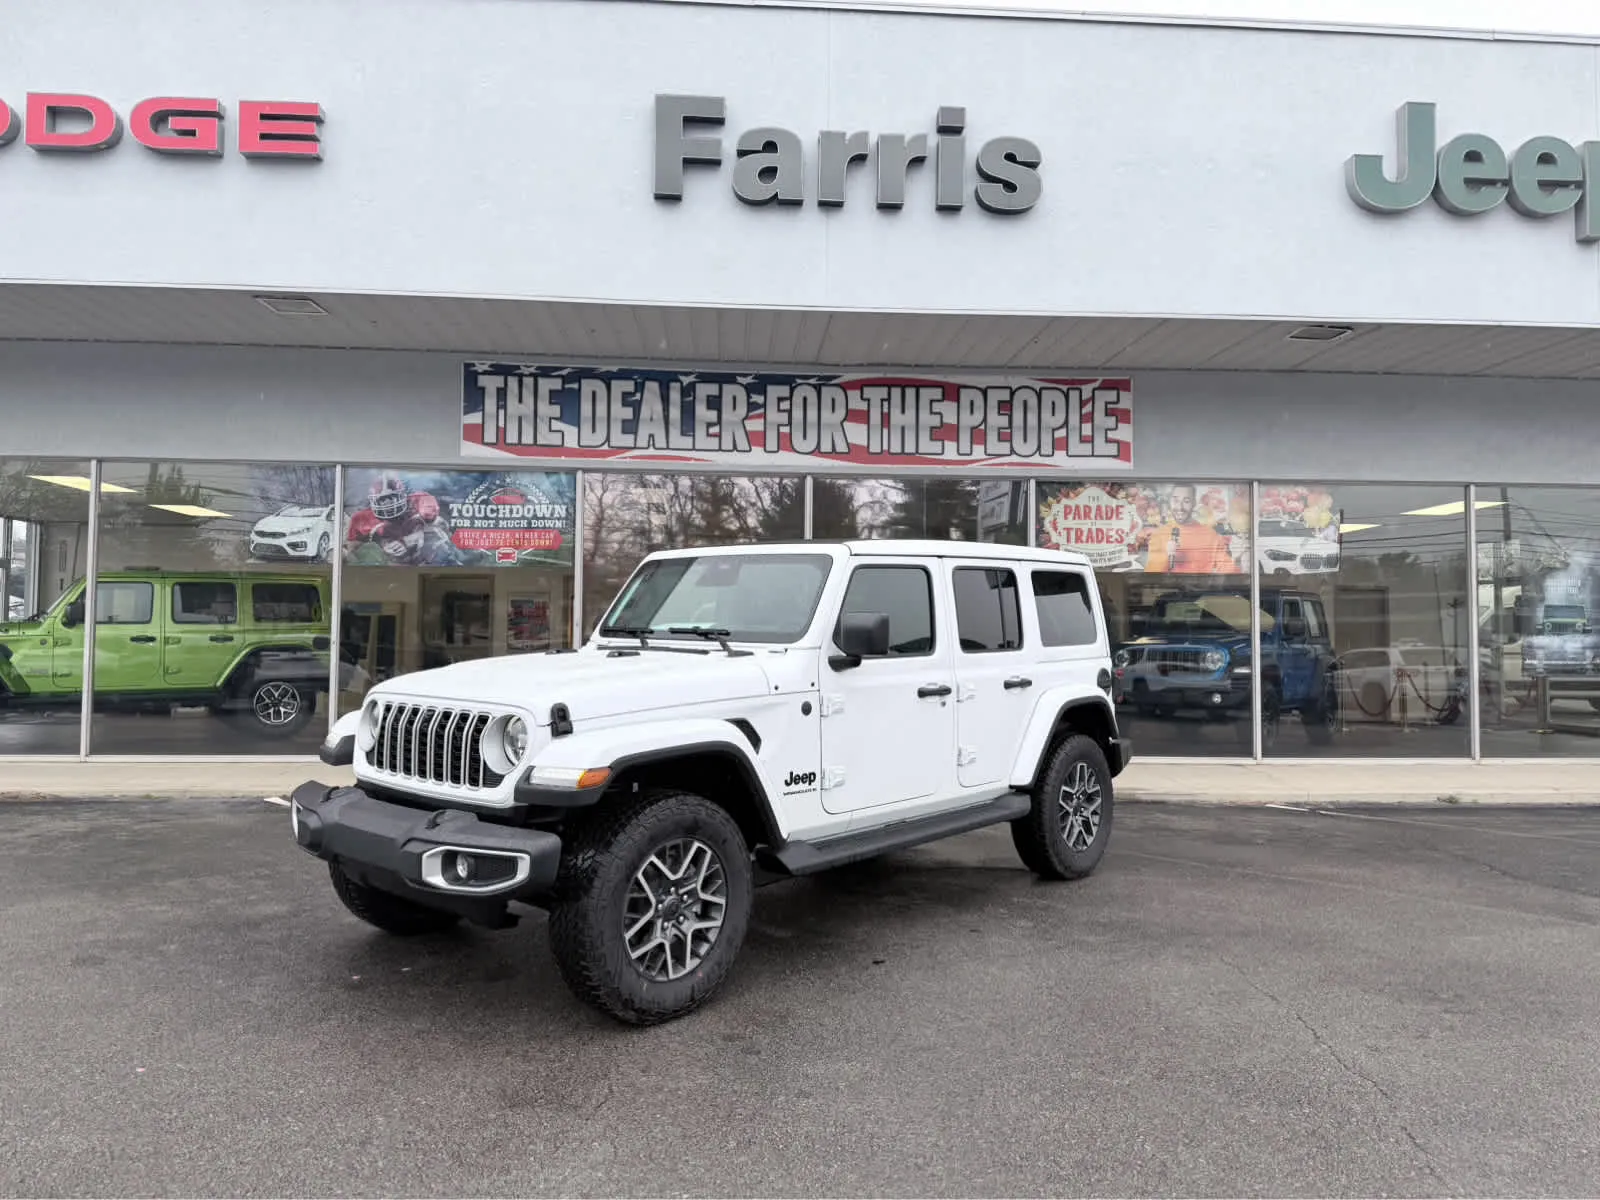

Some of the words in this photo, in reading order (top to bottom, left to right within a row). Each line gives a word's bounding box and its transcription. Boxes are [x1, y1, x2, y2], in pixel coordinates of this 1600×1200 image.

[0, 92, 325, 162] DGE
[653, 93, 1044, 215] Farris
[477, 374, 565, 448] THE
[578, 378, 752, 453] DEALER
[763, 383, 850, 454] FOR
[861, 386, 944, 455] THE
[957, 386, 1121, 458] PEOPLE
[449, 503, 567, 518] TOUCHDOWN
[1063, 504, 1125, 520] PARADE
[450, 519, 471, 527] FOR
[474, 519, 496, 528] NOT
[499, 519, 528, 528] MUCH
[531, 519, 566, 529] DOWN!
[1063, 527, 1126, 544] TRADES
[784, 771, 816, 784] Jeep
